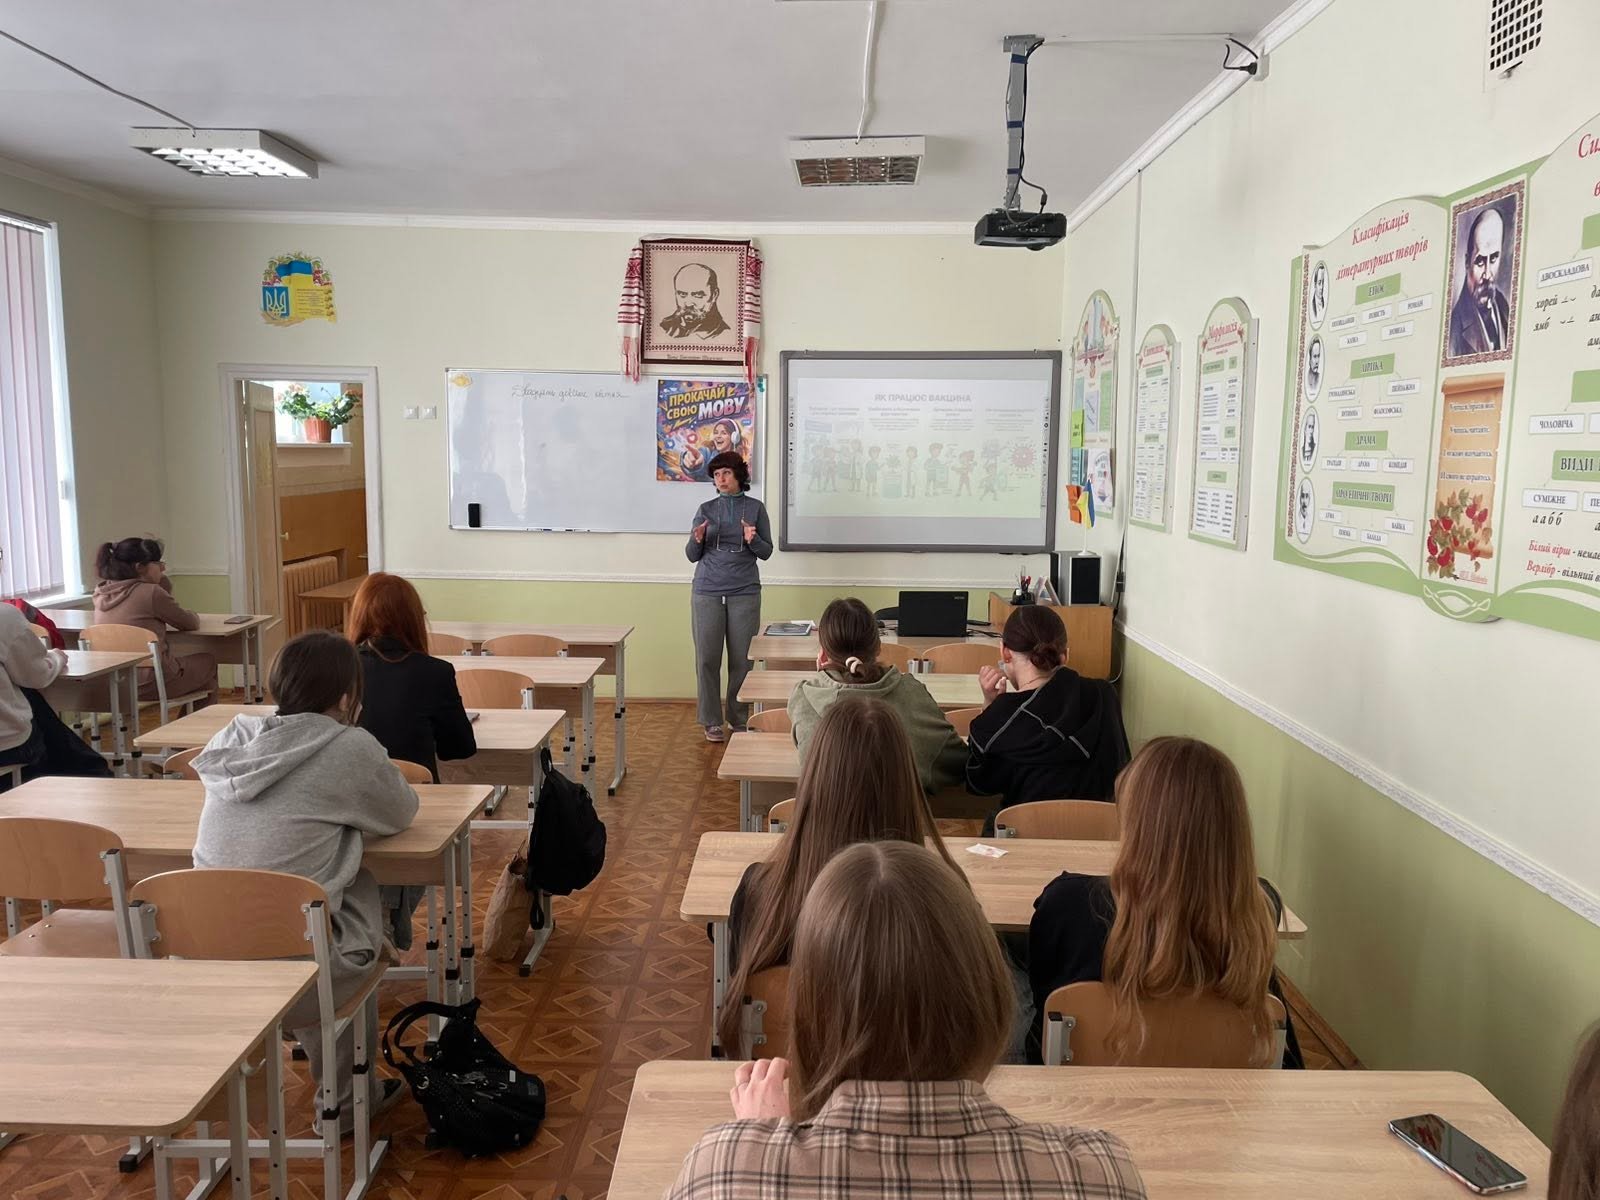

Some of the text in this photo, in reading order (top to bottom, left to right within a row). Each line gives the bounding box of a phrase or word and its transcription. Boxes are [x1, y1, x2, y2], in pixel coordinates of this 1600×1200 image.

[1352, 210, 1409, 246] Класифікація
[1336, 236, 1429, 281] літературних творів
[1541, 263, 1590, 282] ДВОСКЛАДОВА
[1534, 294, 1558, 312] хорей
[1533, 316, 1551, 332] ямб
[669, 385, 725, 407] ПРОКАЧАЙ
[874, 393, 971, 403] ЯК ПРАЦЮЄ ВАКЦИНА
[666, 396, 746, 421] СВОЮ МОВУ
[1539, 420, 1573, 429] ЧОЛОВІЧА
[1356, 435, 1376, 445] ДРАМА
[1560, 457, 1594, 471] ВИДИ
[1371, 491, 1392, 503] ТВОРИ
[1533, 494, 1566, 505] СУМІЖНЕ
[1528, 539, 1551, 553] Білий
[1551, 544, 1571, 558] вірш
[1526, 559, 1556, 578] Верлібр
[1561, 566, 1594, 581] вільний
